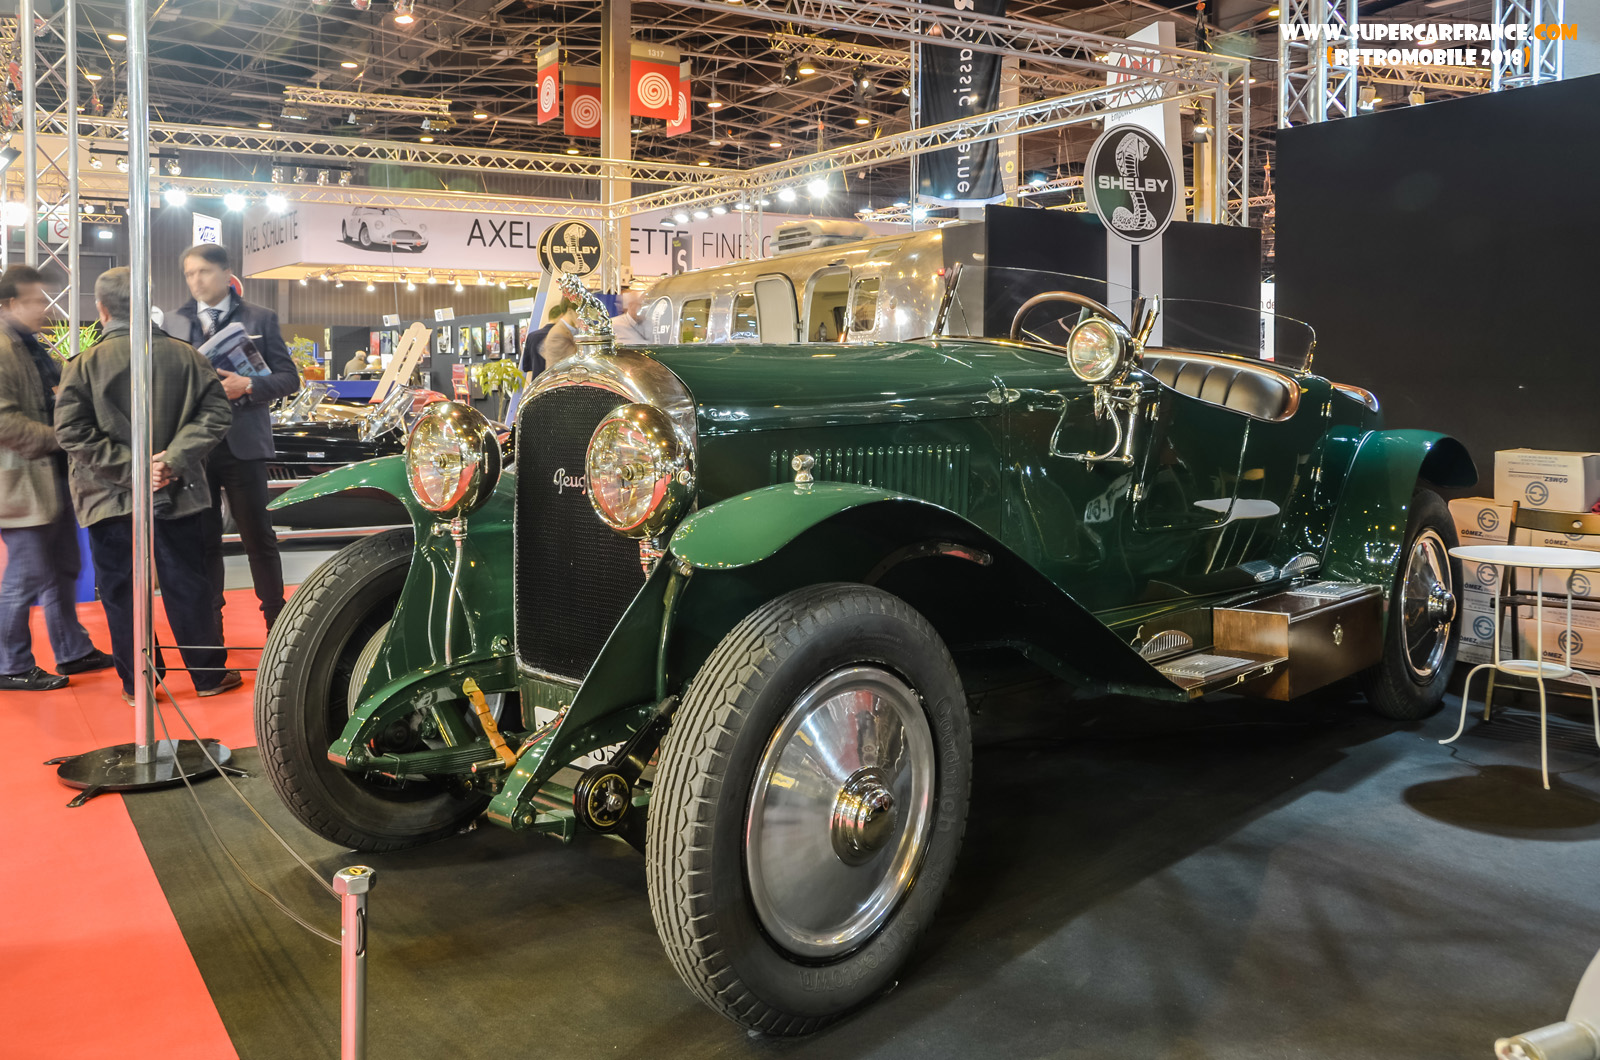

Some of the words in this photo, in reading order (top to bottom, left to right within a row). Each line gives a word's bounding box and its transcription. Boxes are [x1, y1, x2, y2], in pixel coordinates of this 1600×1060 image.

[648, 49, 664, 58] 1317
[1098, 175, 1169, 193] SHELBY
[466, 217, 537, 250] AXEL
[552, 244, 599, 255] SHELBY
[553, 467, 587, 496] Peug
[1464, 582, 1483, 591] ÓMEZ
[1460, 635, 1478, 644] ÓMEZ
[1543, 650, 1563, 659] ÓMEZ
[935, 695, 961, 834] Goodrich
